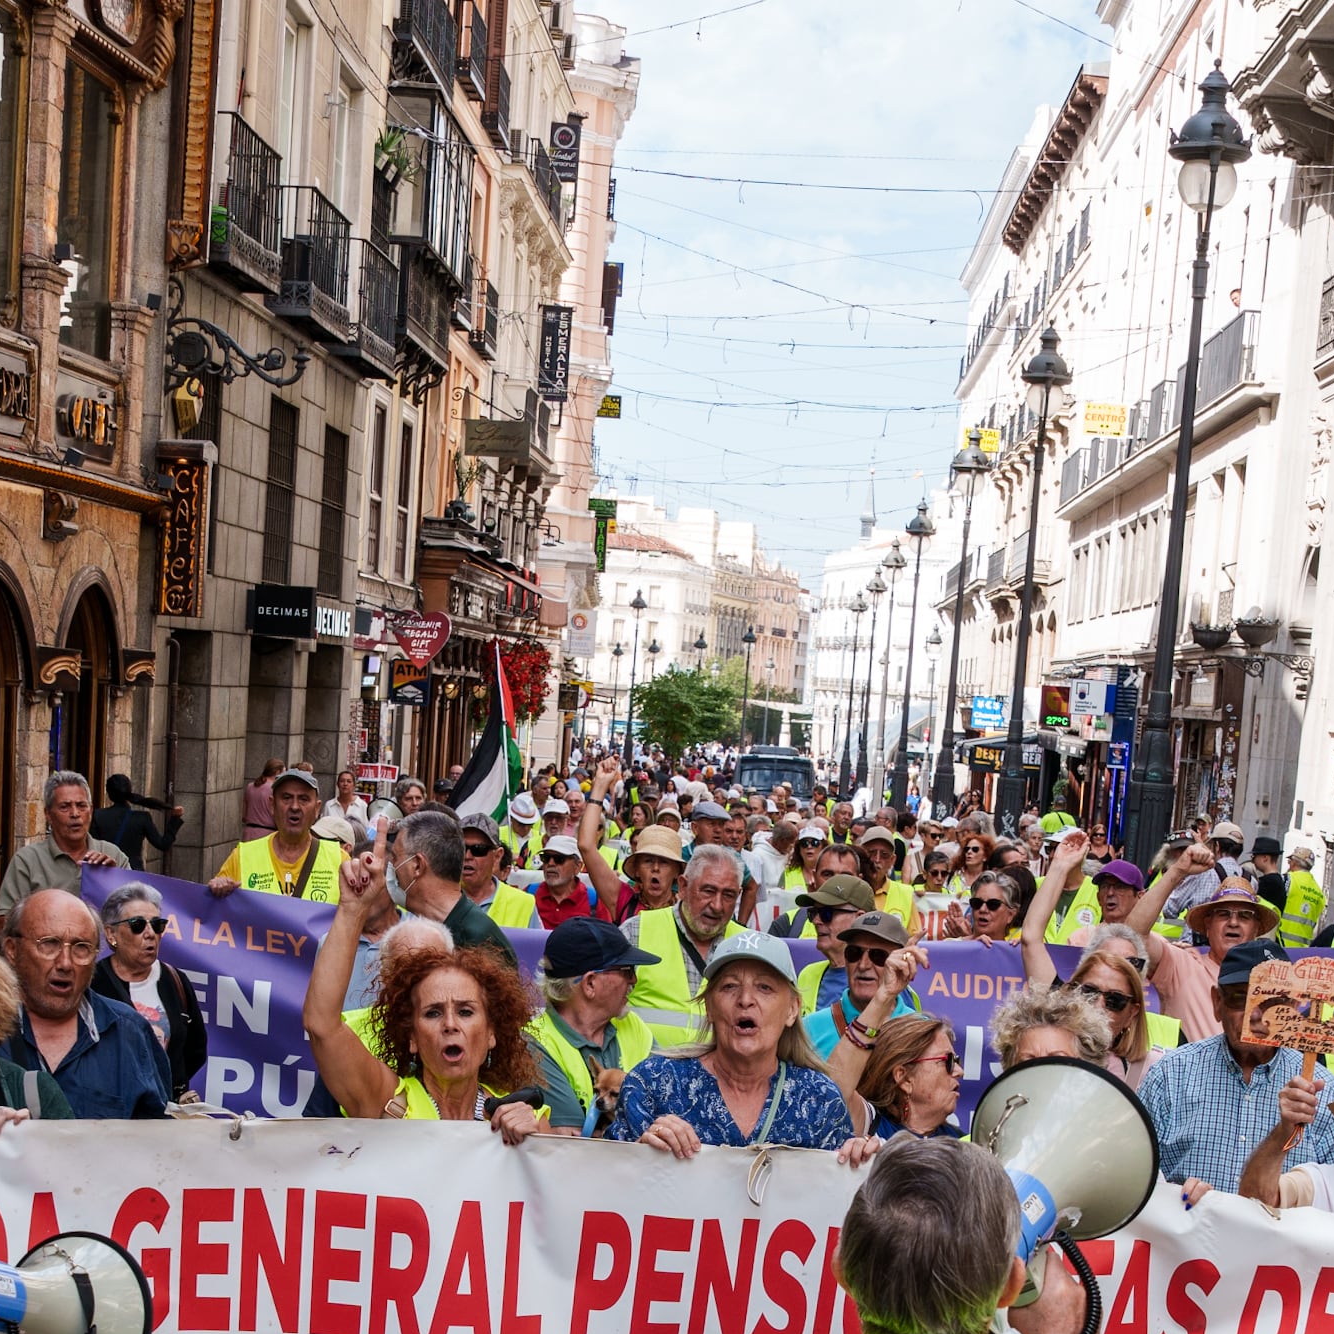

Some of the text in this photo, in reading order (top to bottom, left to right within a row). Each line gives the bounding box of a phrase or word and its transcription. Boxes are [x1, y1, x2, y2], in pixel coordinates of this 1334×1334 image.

[555, 312, 569, 388] ESMERALDA
[1084, 412, 1126, 423] CENTRO
[258, 606, 308, 618] DECIMAS
[317, 607, 351, 638] DECIMAS
[411, 639, 431, 648] GIFT
[395, 664, 427, 677] ATM
[975, 747, 999, 761] BEST
[192, 920, 236, 949] LA
[245, 927, 308, 957] LEY
[1269, 963, 1289, 980] NO
[928, 971, 1028, 1000] AUDIT
